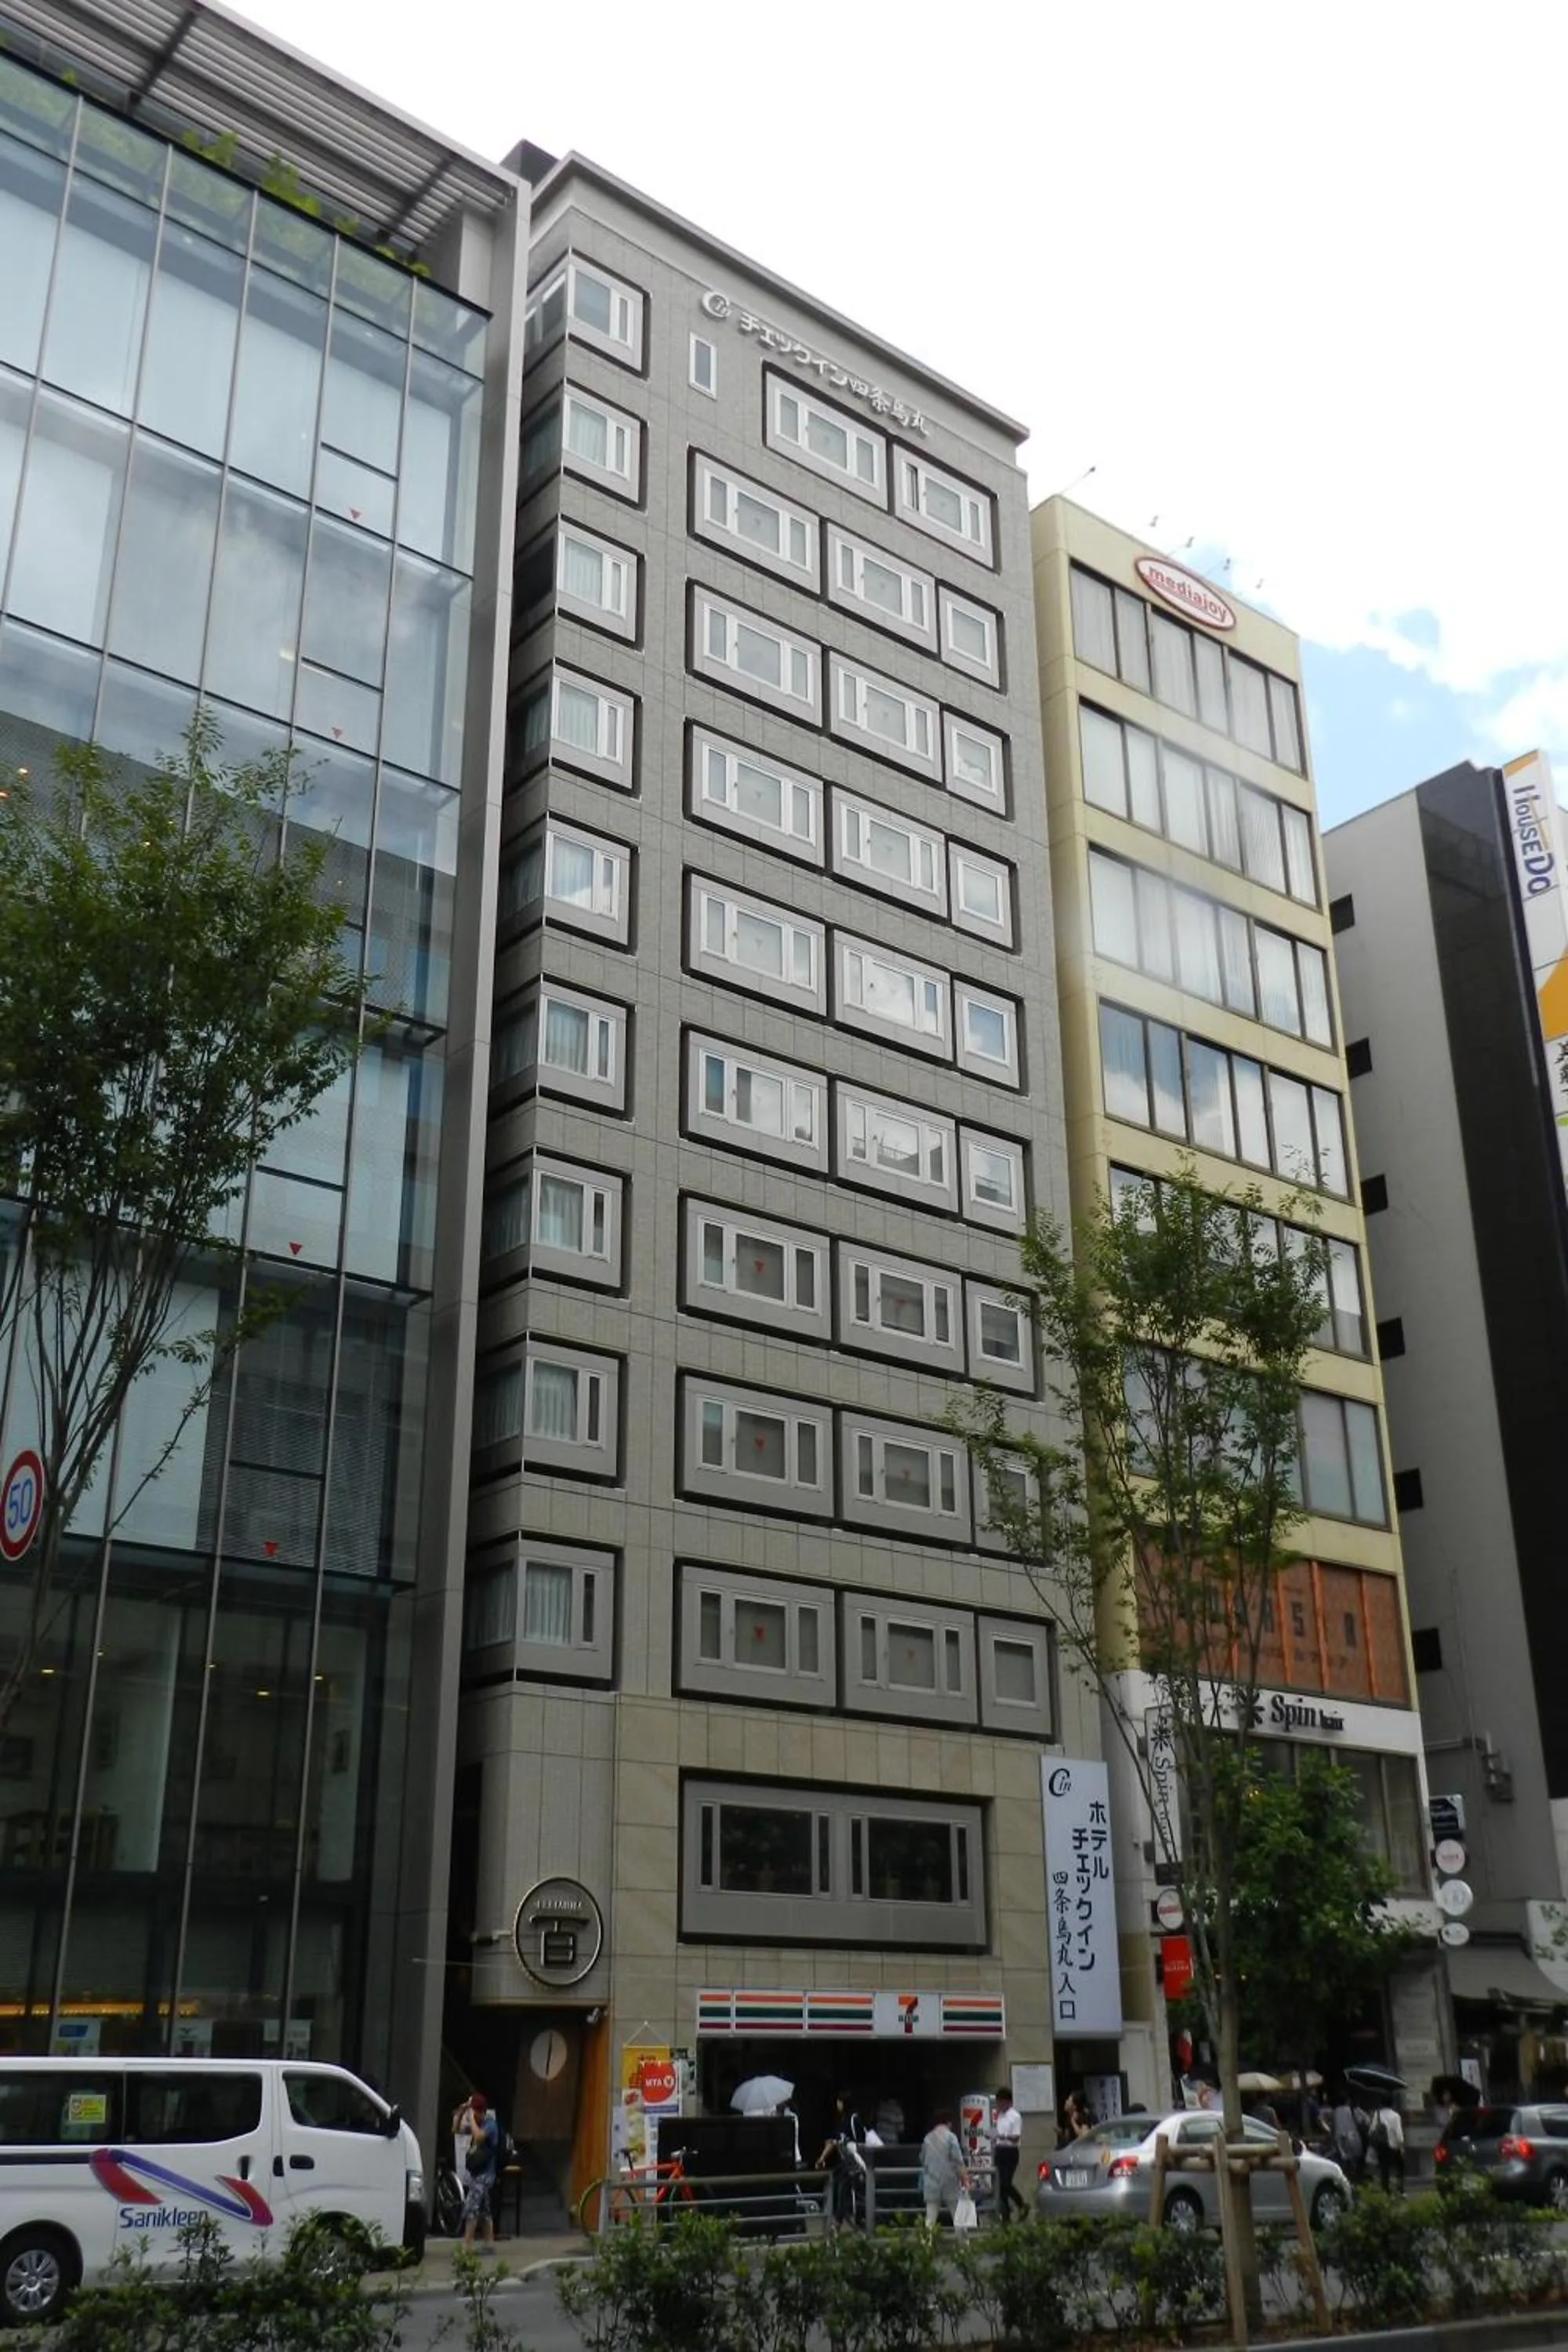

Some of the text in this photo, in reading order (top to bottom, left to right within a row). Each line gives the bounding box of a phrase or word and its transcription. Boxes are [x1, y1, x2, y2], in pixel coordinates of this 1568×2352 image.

[1149, 566, 1228, 623] mediajoy
[8, 1478, 34, 1530] 50
[1271, 1693, 1316, 1732] Spin
[1090, 1800, 1109, 1879] ホテル
[120, 2207, 209, 2228] Sanikleen
